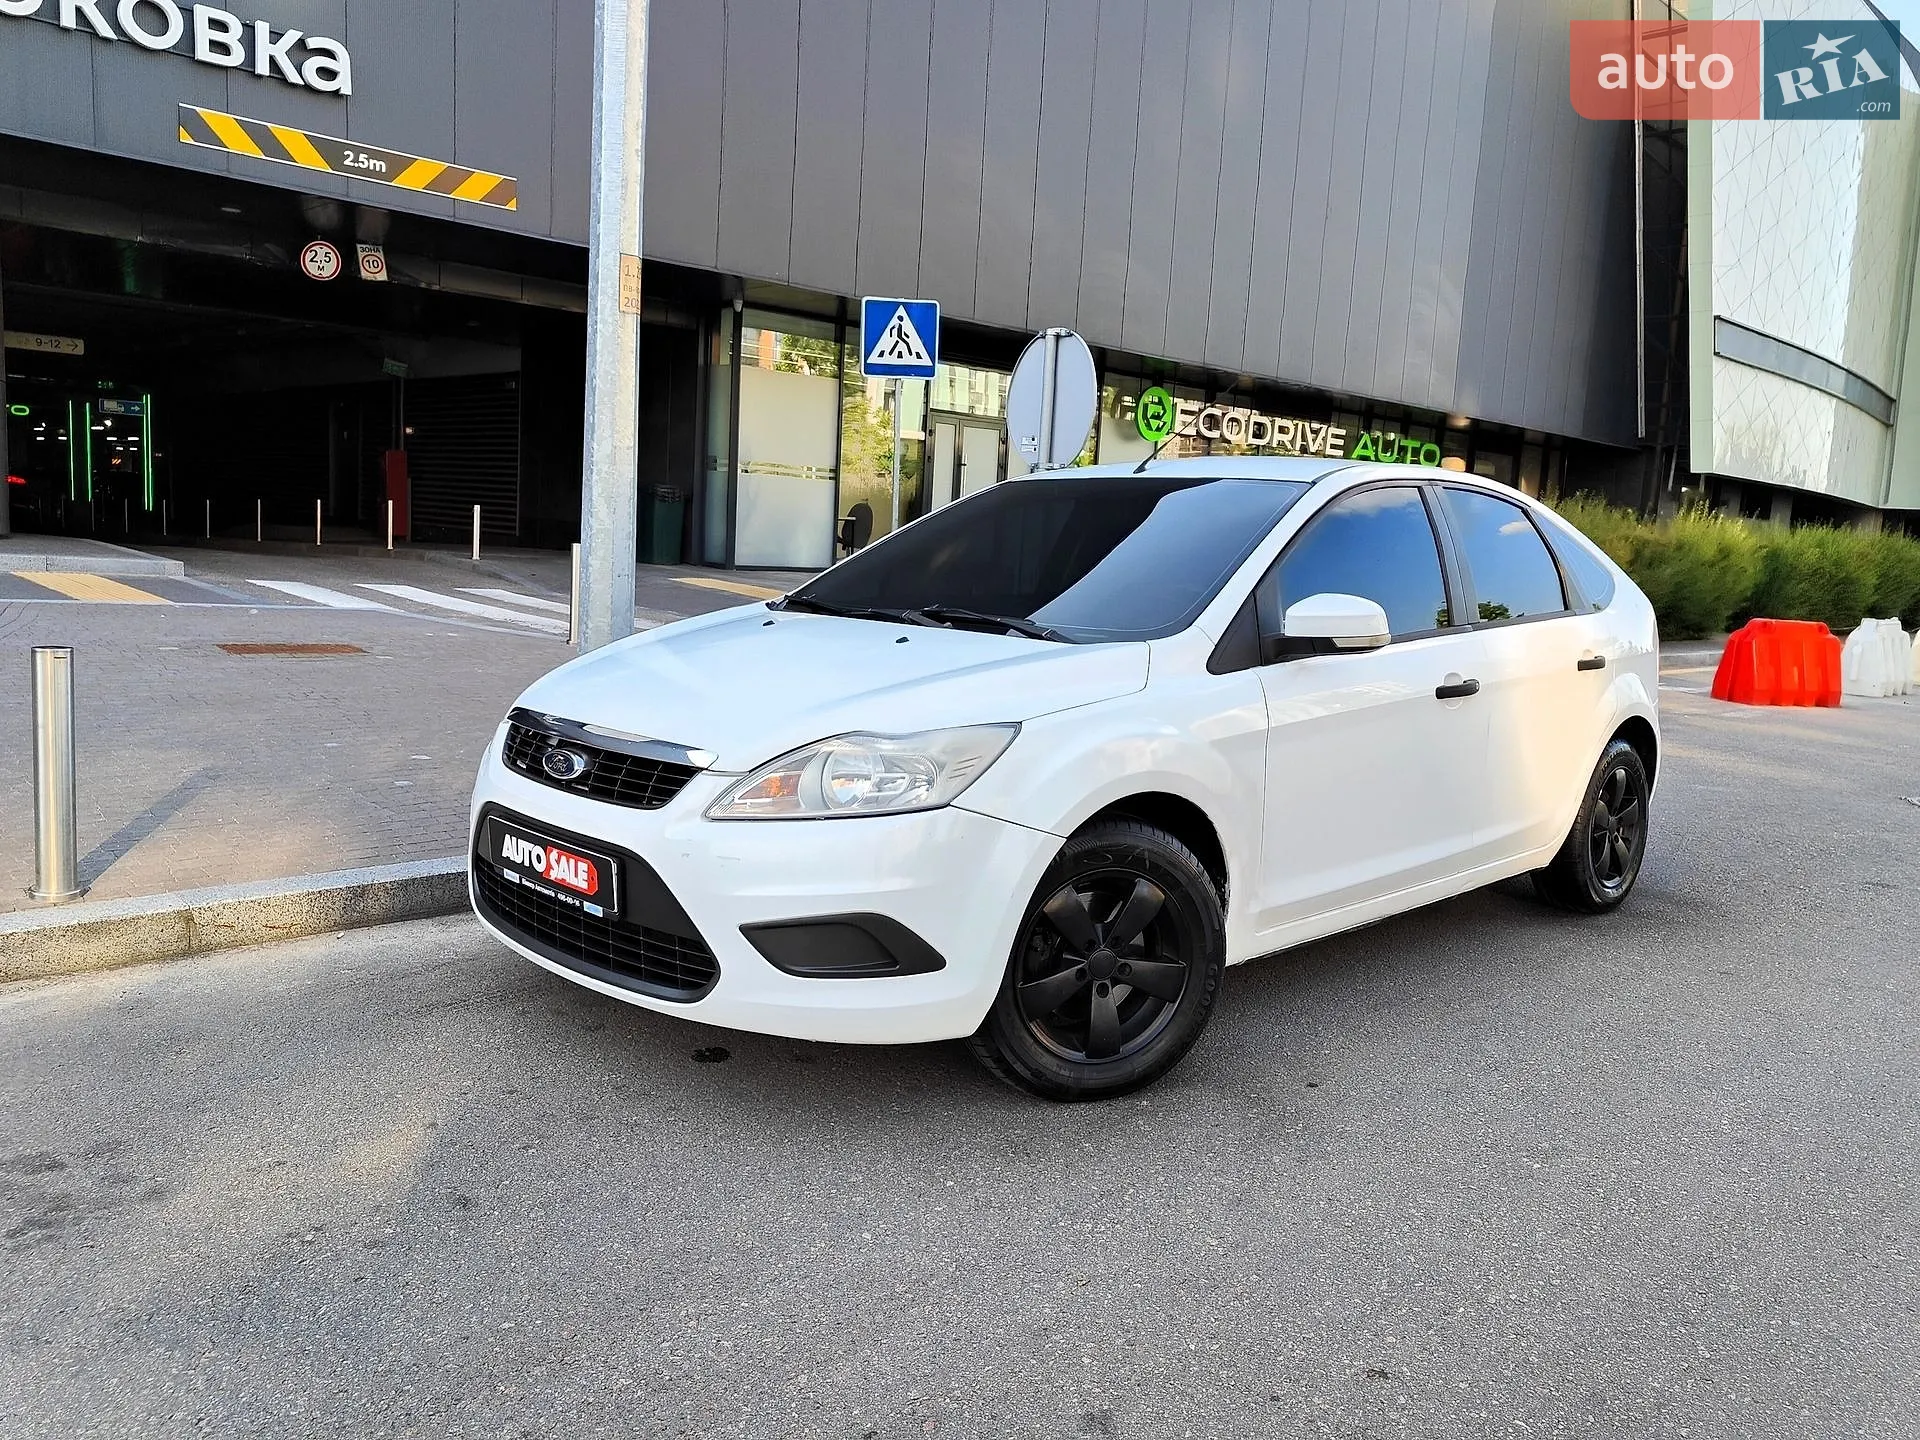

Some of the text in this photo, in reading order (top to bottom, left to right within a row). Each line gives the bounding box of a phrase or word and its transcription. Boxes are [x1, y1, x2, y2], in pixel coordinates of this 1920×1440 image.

[343, 150, 387, 173] 2.5m
[308, 249, 332, 265] 2,5
[365, 260, 380, 269] 10
[35, 337, 62, 349] 9-12
[1173, 401, 1441, 467] ECODRIVE AUTO
[501, 833, 547, 873] AUTO
[549, 848, 589, 890] SALE
